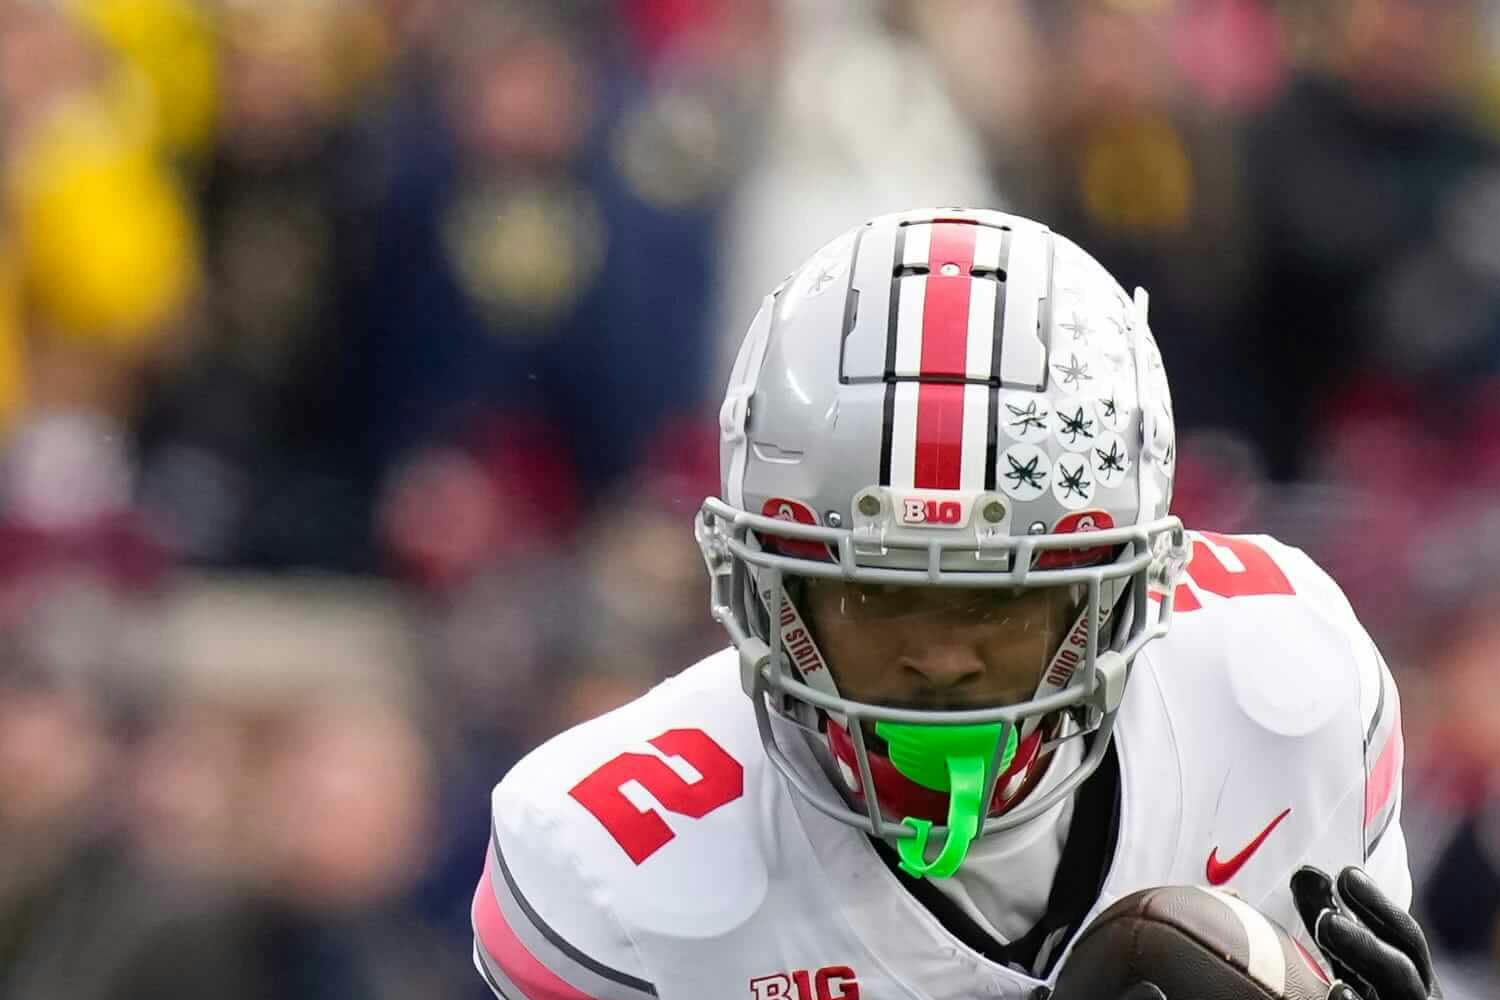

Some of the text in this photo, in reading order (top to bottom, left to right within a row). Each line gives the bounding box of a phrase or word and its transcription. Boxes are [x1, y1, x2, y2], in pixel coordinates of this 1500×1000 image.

[785, 628, 823, 676] STATE
[1046, 650, 1079, 687] OHIO
[567, 728, 744, 867] 2
